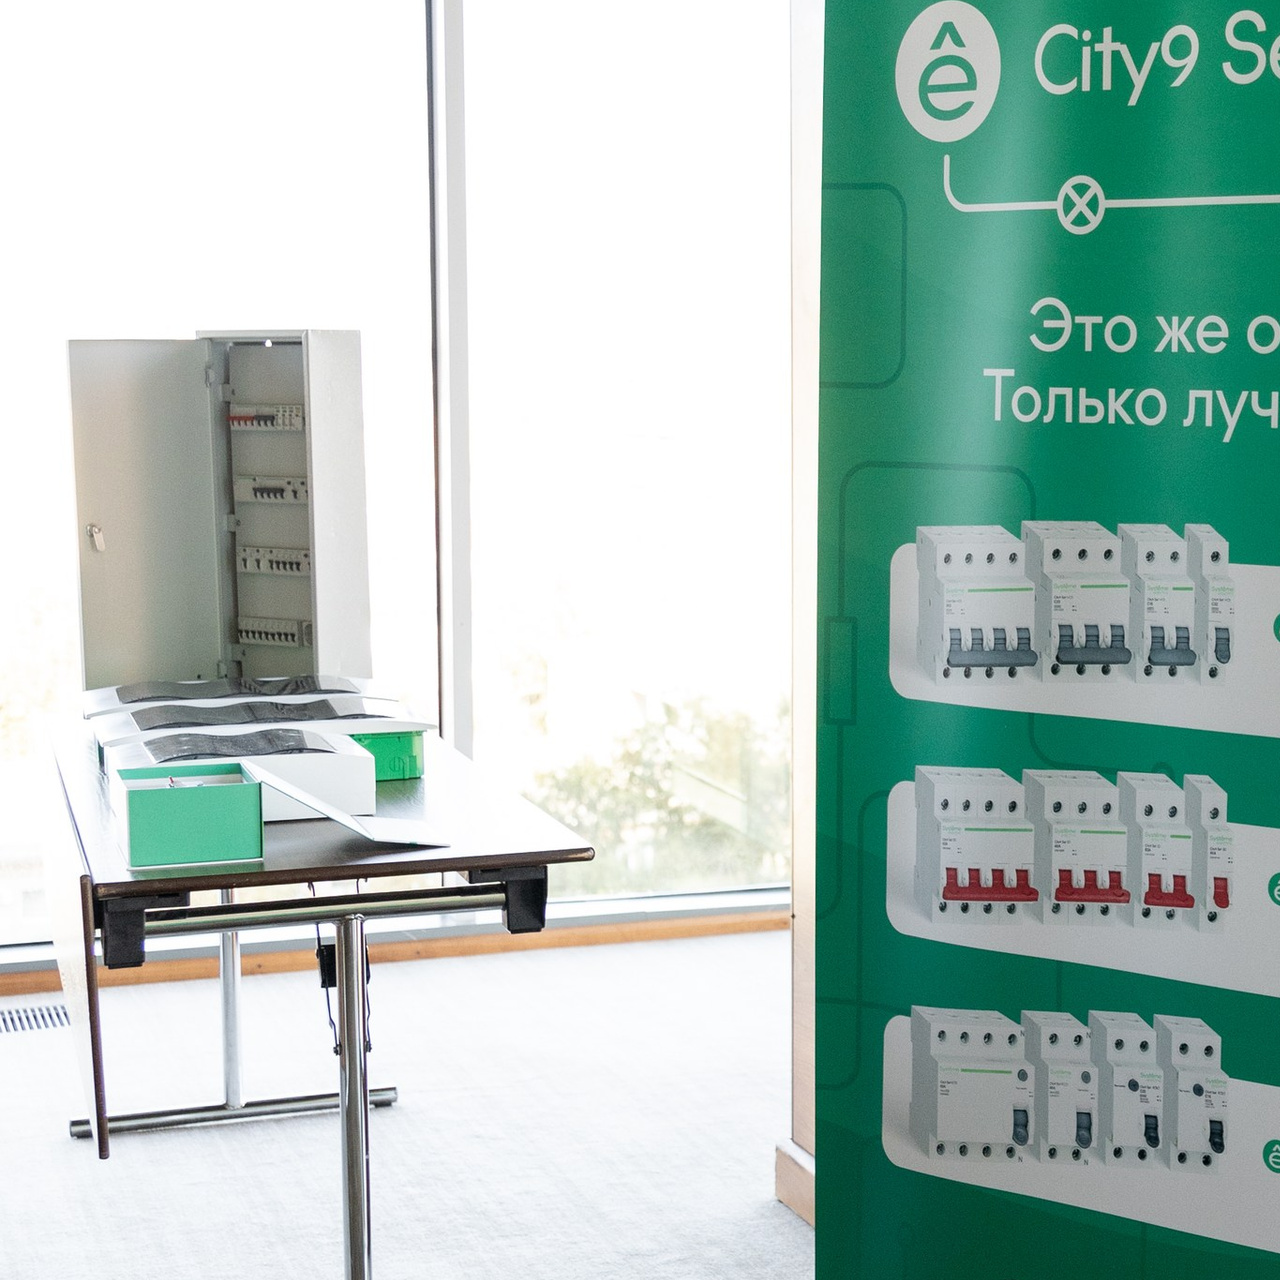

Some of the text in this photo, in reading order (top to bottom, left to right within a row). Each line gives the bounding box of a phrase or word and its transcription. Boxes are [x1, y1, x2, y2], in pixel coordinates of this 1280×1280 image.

[1034, 23, 1199, 106] City9
[1028, 297, 1138, 354] Это
[1154, 314, 1229, 354] же
[983, 368, 1167, 426] Только
